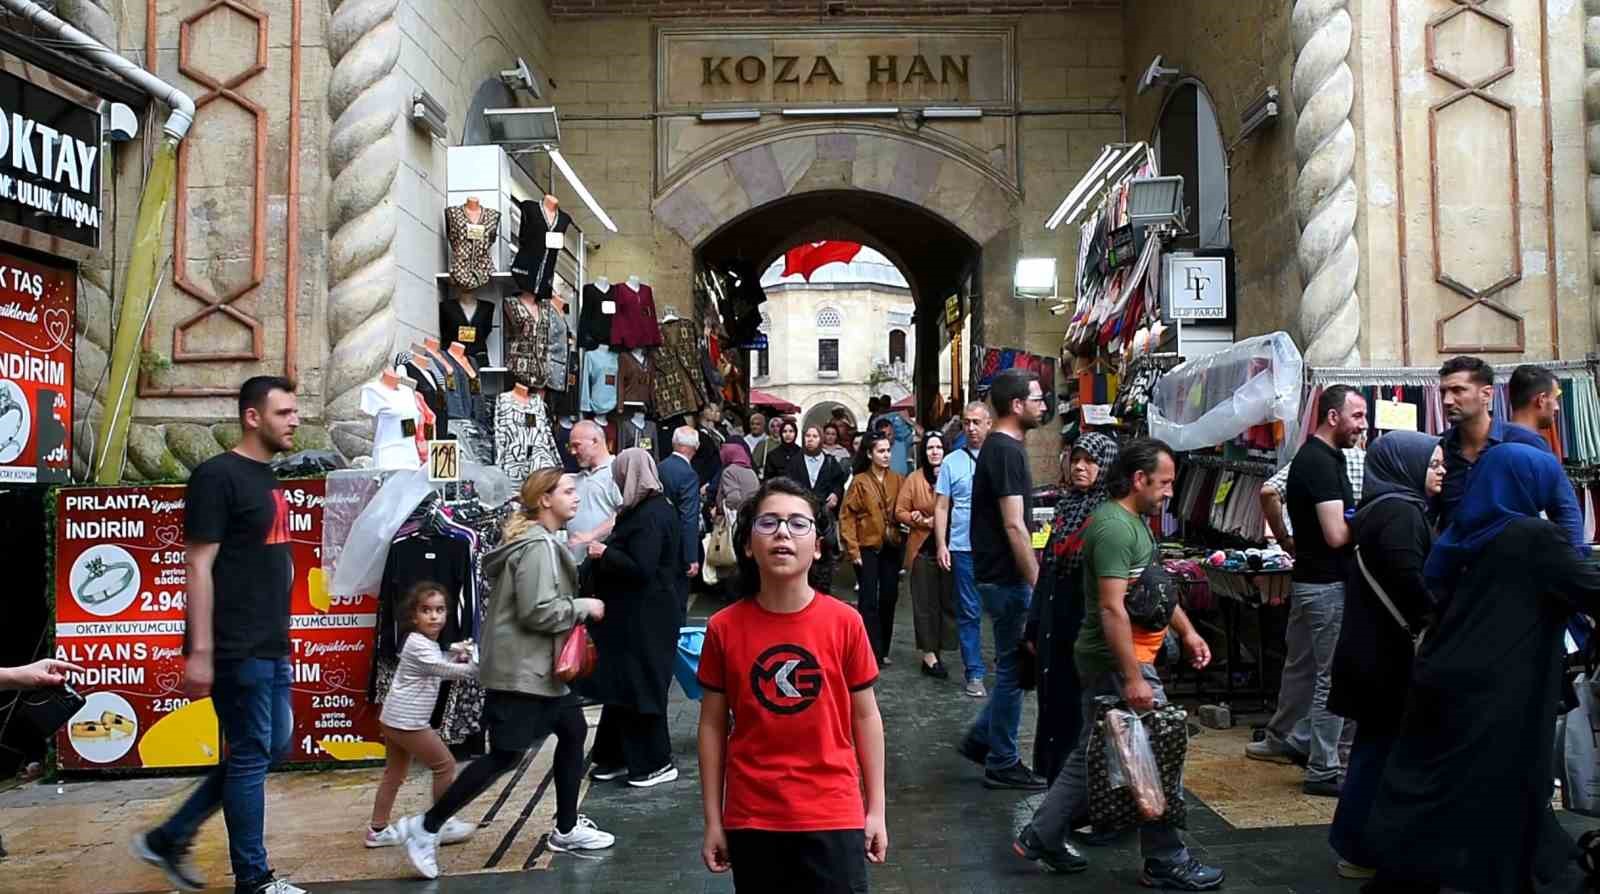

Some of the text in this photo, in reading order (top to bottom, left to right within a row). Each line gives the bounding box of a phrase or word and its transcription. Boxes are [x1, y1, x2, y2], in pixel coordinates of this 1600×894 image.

[701, 54, 971, 86] KOZA HAN
[61, 192, 101, 228] İNŞAA
[10, 268, 43, 301] TAŞ
[65, 494, 150, 511] PIRLANTA
[65, 518, 145, 539] İNDİRİM
[76, 622, 112, 635] OKTAY
[55, 642, 148, 662] ALYANS
